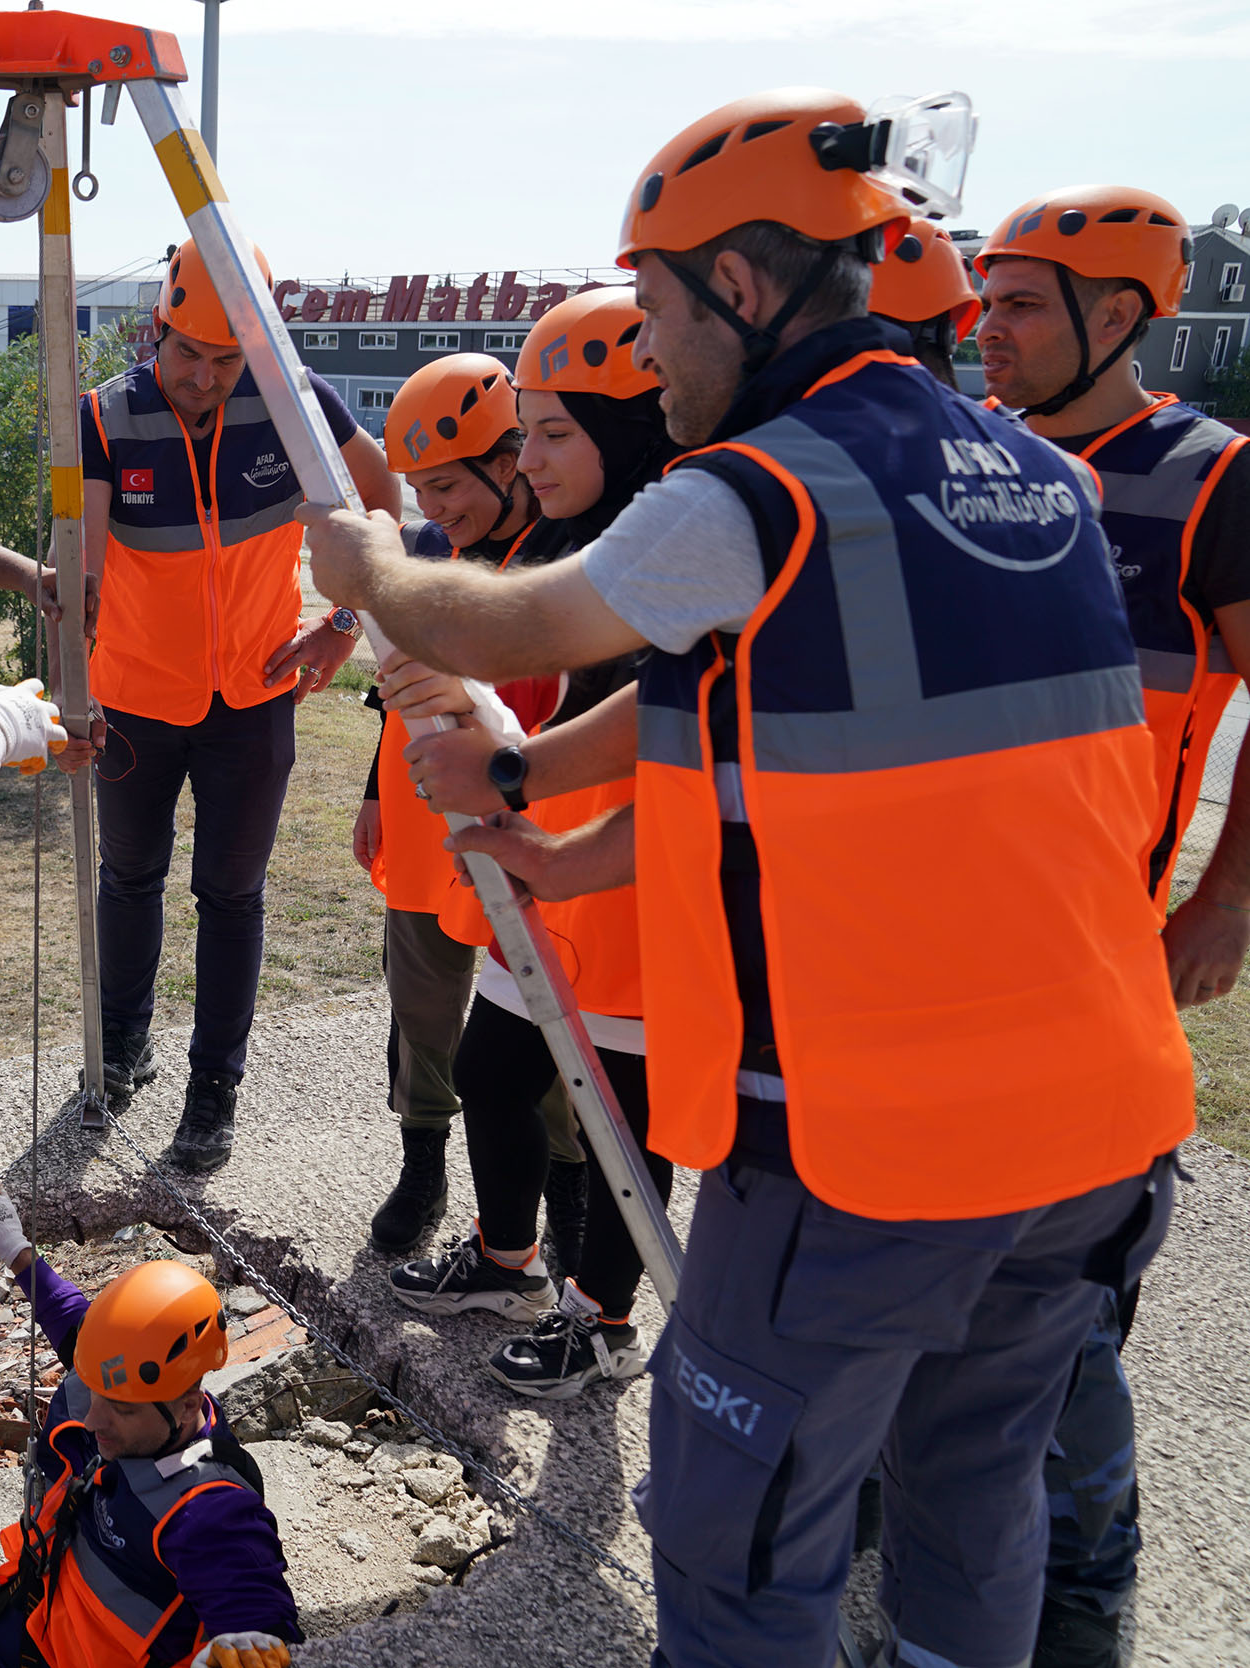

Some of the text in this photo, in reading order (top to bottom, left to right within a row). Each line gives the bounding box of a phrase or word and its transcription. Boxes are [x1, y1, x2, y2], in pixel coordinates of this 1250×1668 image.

[273, 271, 636, 322] Cem Matba
[256, 453, 275, 466] AFAD
[121, 492, 154, 504] TÜRKİYE
